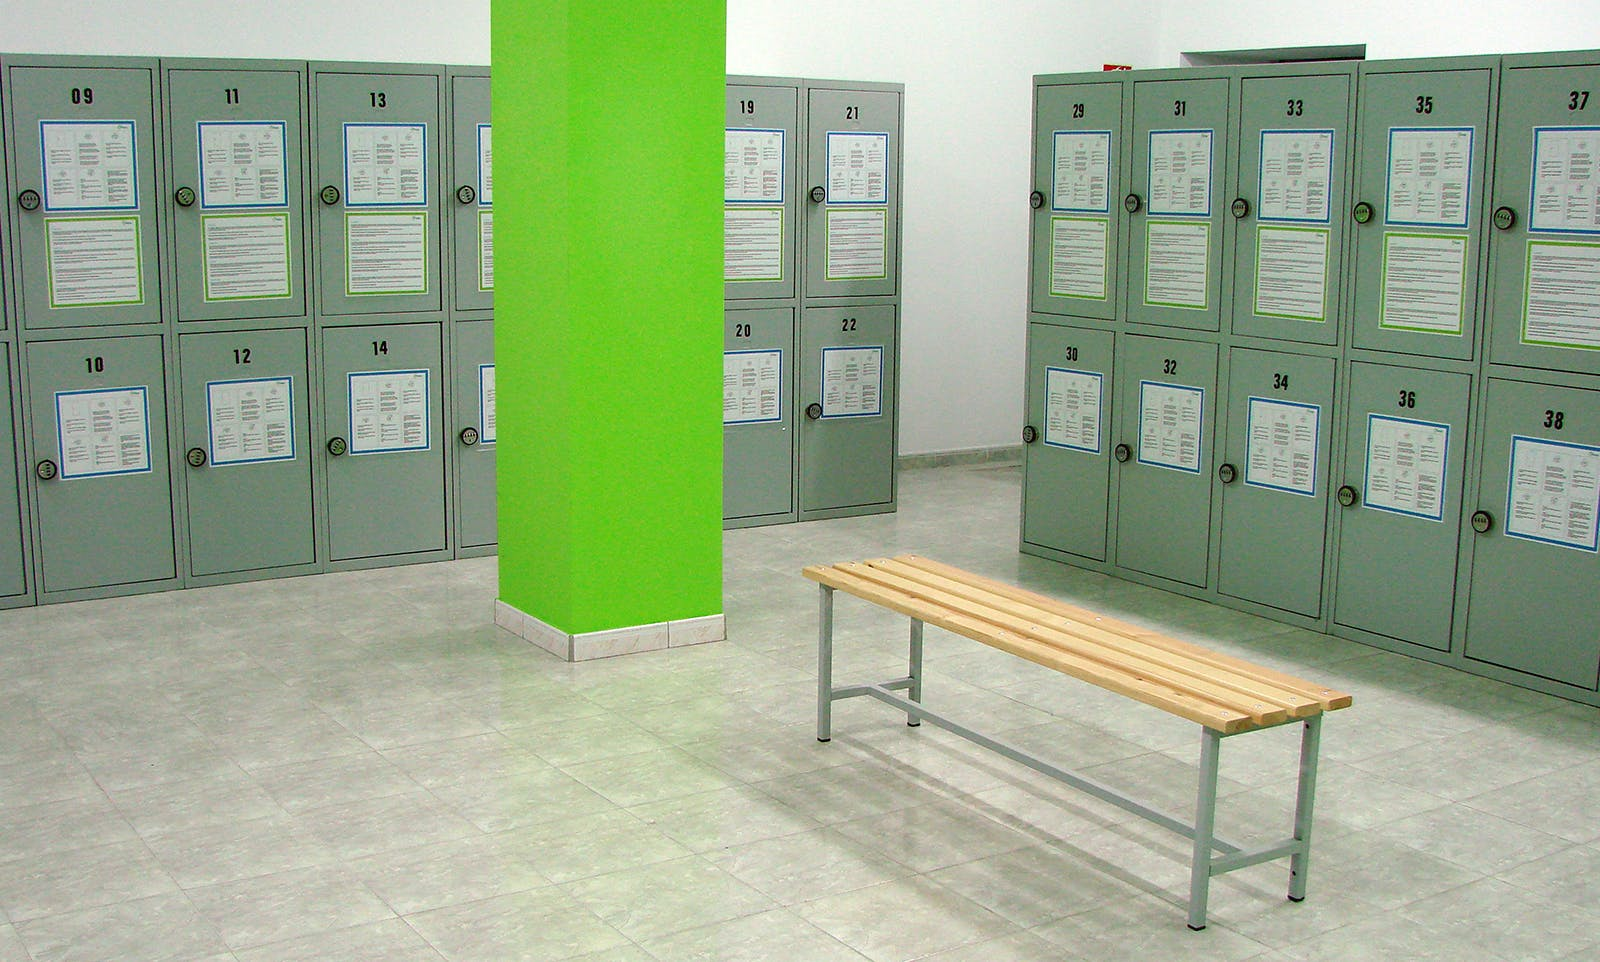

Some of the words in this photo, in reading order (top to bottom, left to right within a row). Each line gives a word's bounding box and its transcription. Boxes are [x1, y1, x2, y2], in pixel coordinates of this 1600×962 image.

[72, 88, 92, 104] 09
[225, 89, 238, 104] 11
[370, 93, 386, 107] 13
[1569, 91, 1589, 110] 37
[741, 101, 753, 113] 19
[1073, 104, 1084, 118] 29
[1175, 101, 1185, 116] 31
[1287, 100, 1303, 116] 33
[1416, 96, 1432, 114] 35
[847, 107, 858, 119] 21
[736, 324, 750, 337] 20
[842, 318, 856, 331] 22
[372, 341, 387, 355] 14
[1066, 347, 1077, 361] 30
[234, 349, 250, 364] 12
[86, 357, 103, 373] 10
[1164, 359, 1176, 375] 32
[1274, 373, 1288, 390] 34
[1399, 390, 1415, 408] 36
[1544, 410, 1564, 430] 38
